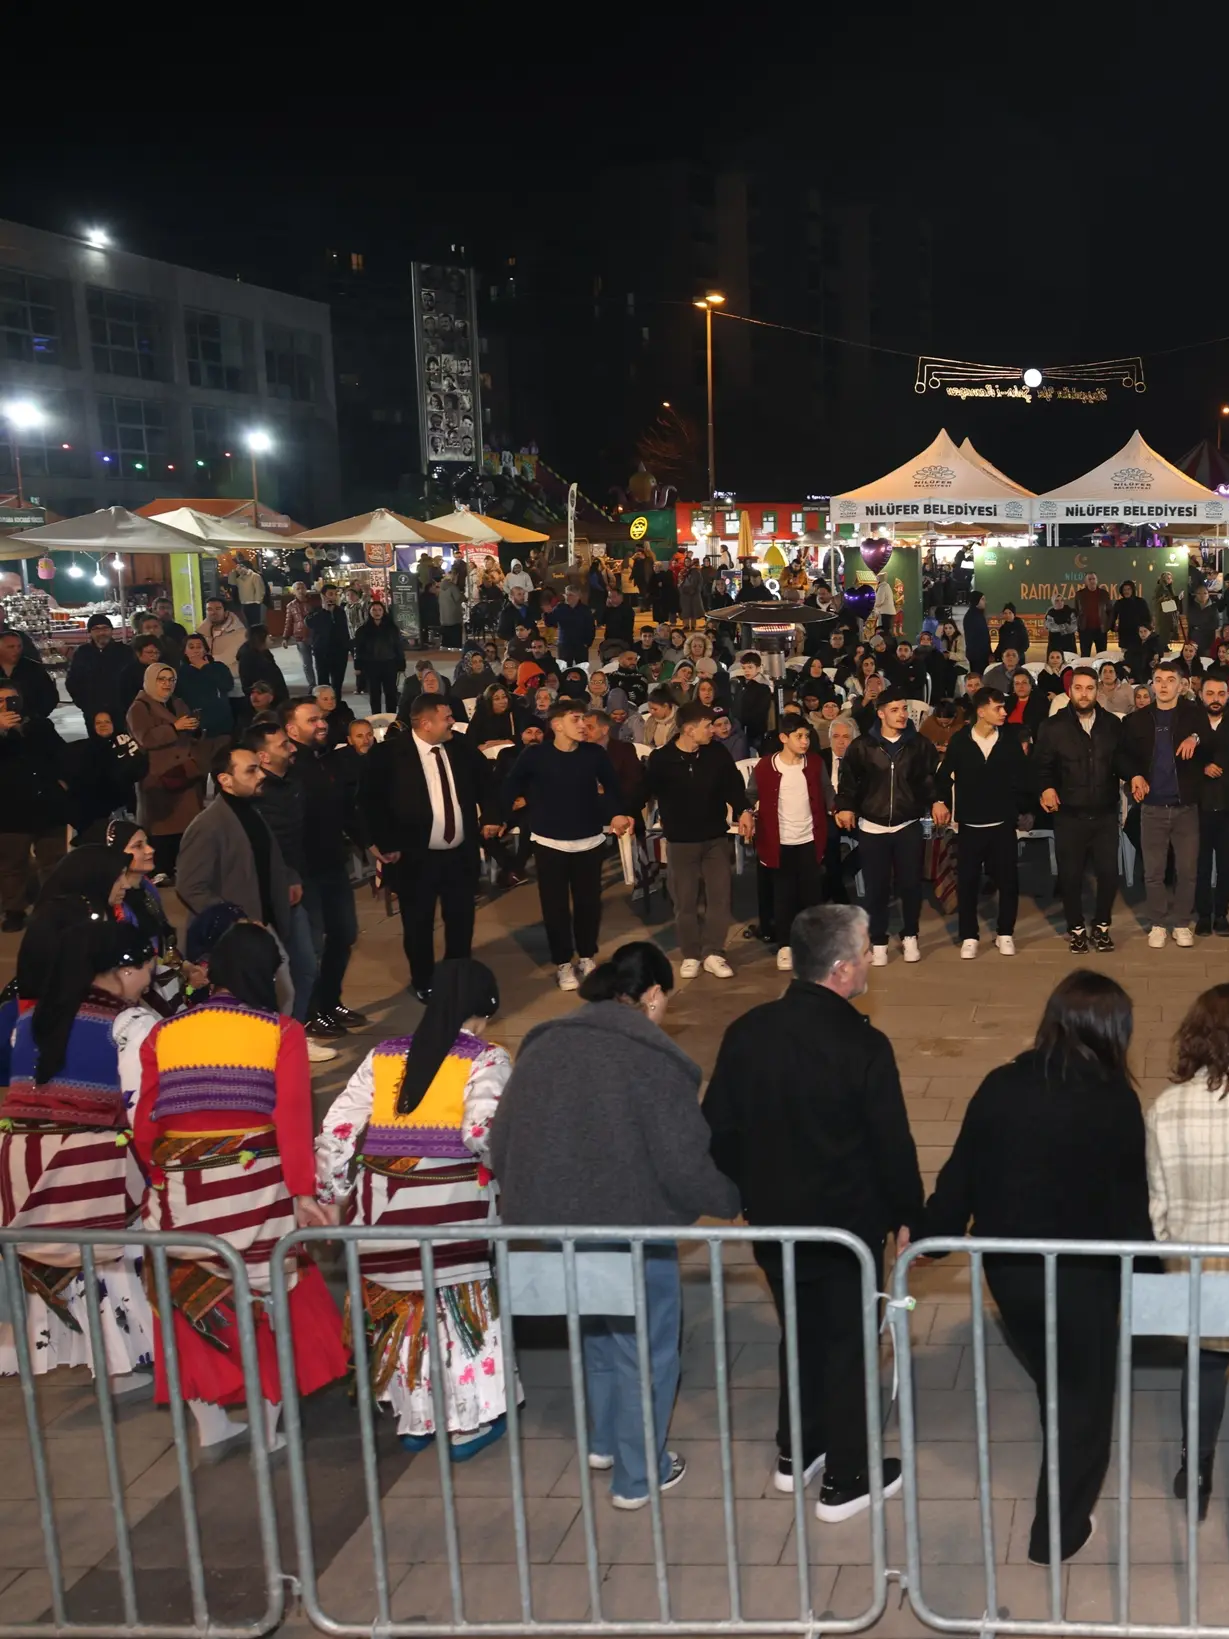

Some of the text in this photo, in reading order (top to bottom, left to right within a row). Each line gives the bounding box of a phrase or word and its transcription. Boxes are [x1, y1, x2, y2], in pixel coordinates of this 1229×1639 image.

[865, 503, 919, 516] NİLÜFER
[923, 502, 997, 517] BELEDİYESİ
[1065, 504, 1119, 517] NİLÜFER
[1123, 504, 1197, 517] BELEDİYESİ
